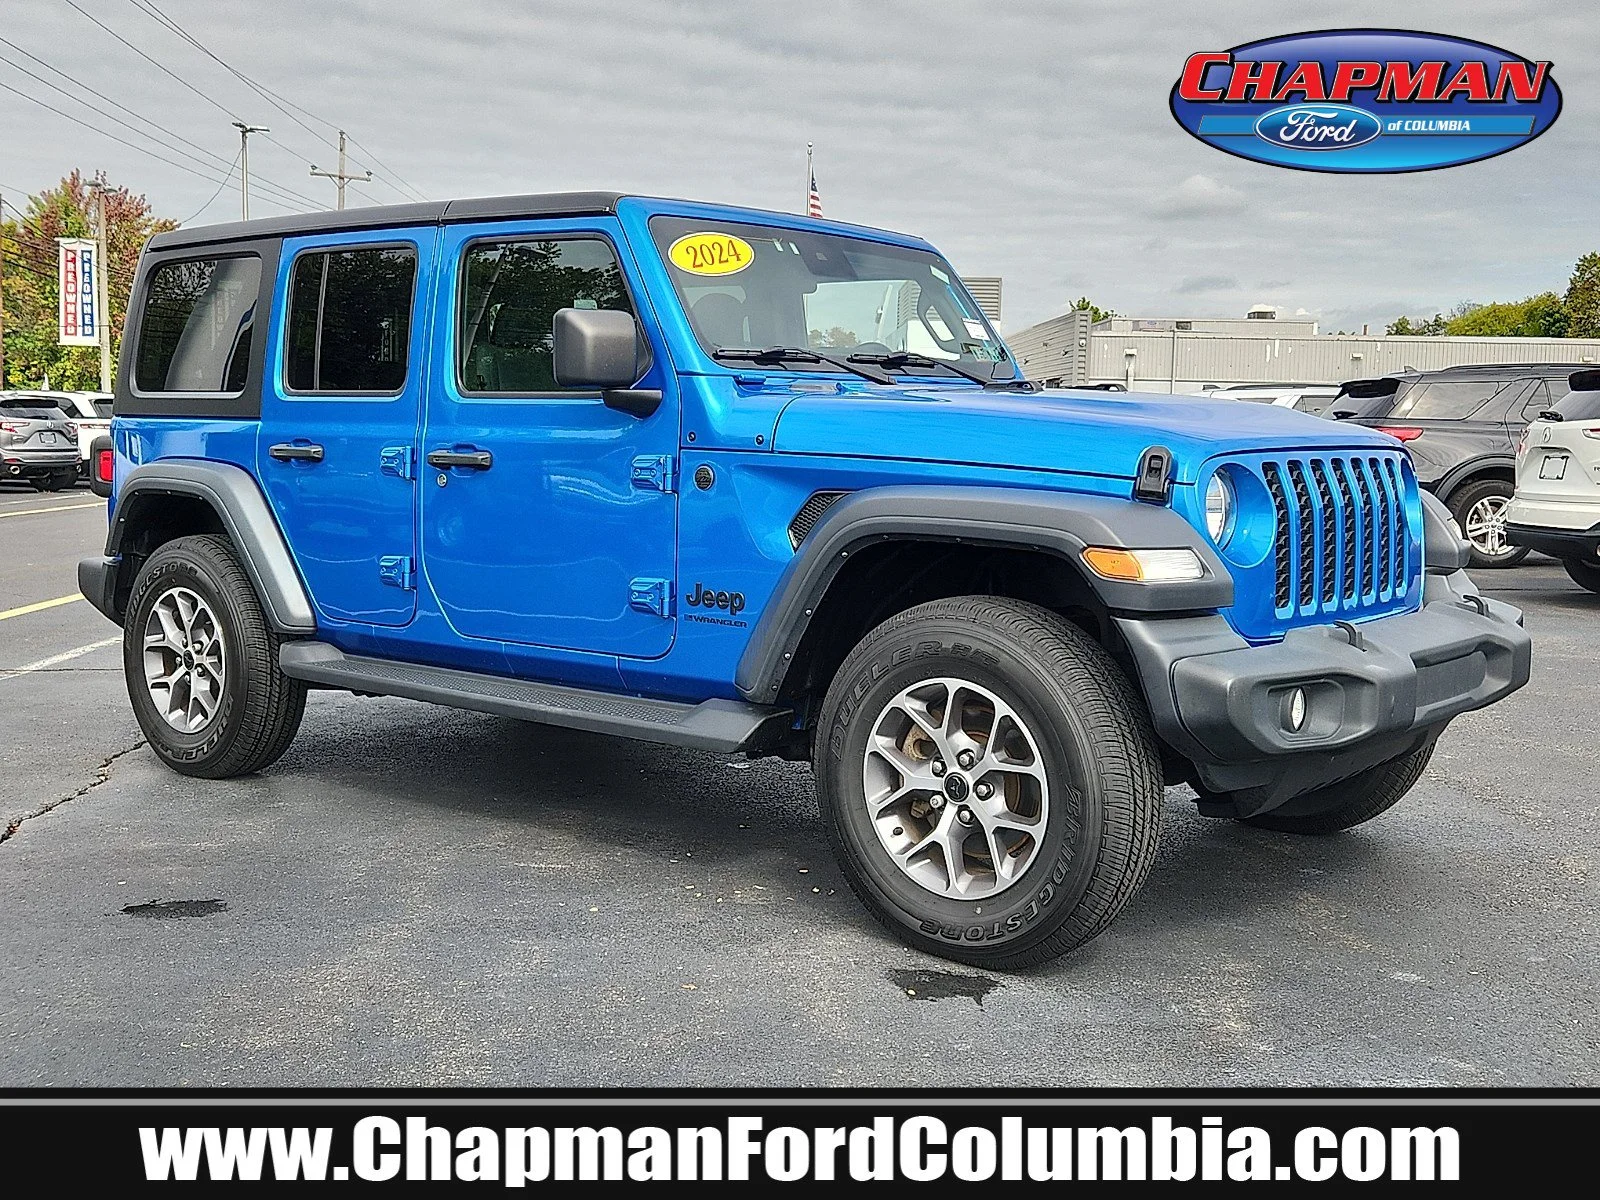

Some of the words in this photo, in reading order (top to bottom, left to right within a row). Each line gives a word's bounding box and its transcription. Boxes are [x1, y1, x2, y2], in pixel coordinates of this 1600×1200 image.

[686, 239, 742, 268] 2024
[686, 582, 746, 616] Jeep
[693, 614, 748, 628] WRANGLER
[831, 640, 943, 760] DUELER
[919, 782, 1083, 942] BRIDGESTONE
